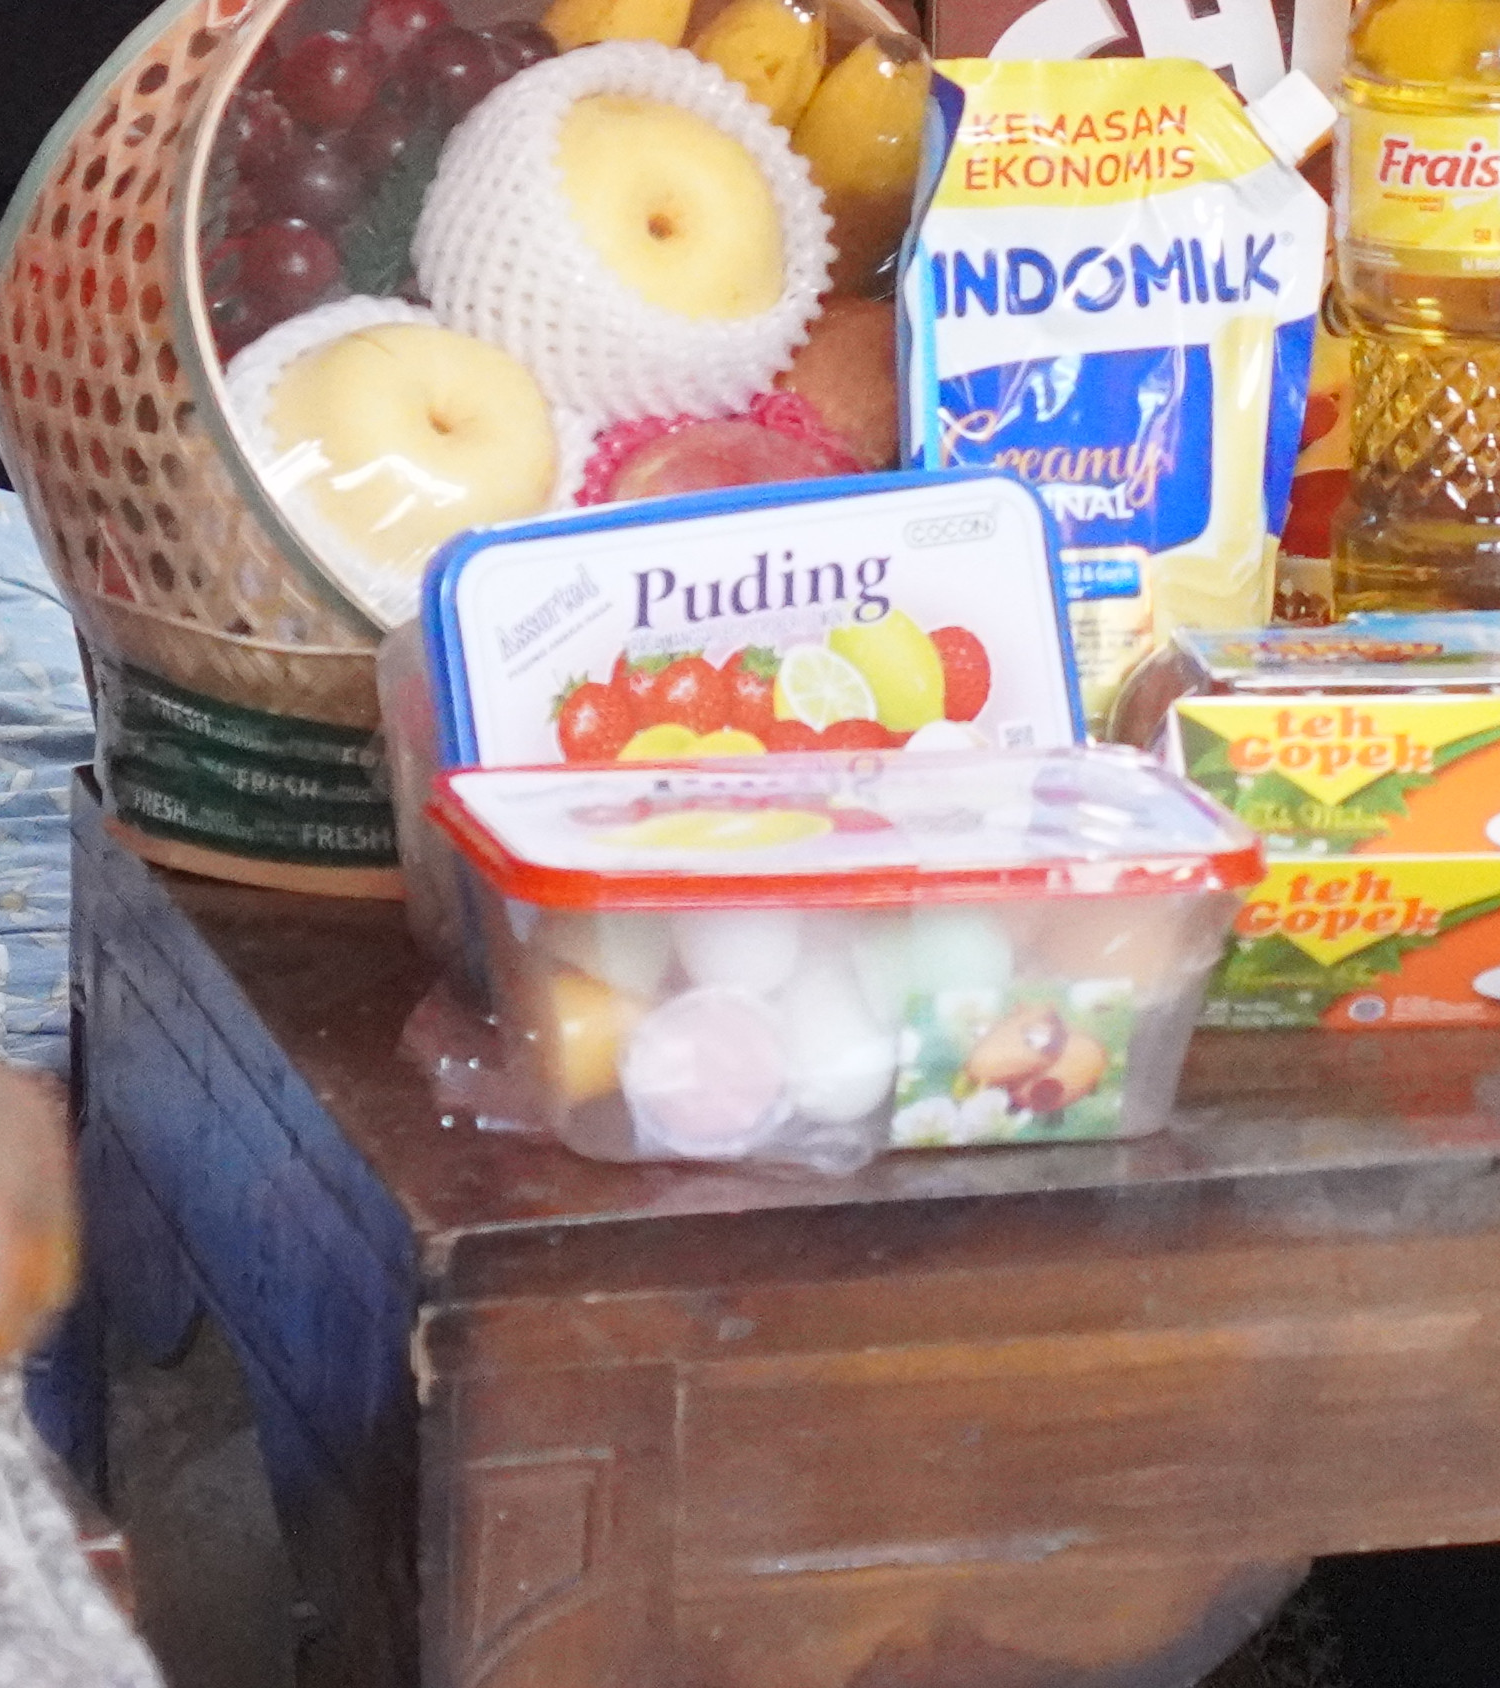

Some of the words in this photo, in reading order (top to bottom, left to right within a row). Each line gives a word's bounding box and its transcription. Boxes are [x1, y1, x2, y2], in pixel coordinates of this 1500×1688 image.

[972, 103, 1187, 148] KEMASAN
[963, 153, 1195, 191] EKONOMIS
[932, 231, 1282, 320] INDOMILK
[494, 562, 600, 662] Assorted
[630, 550, 891, 630] Puding
[1275, 706, 1376, 740] teh
[1226, 732, 1435, 777] Gopek
[1288, 869, 1392, 904] teh
[1231, 896, 1443, 941] Gopek
